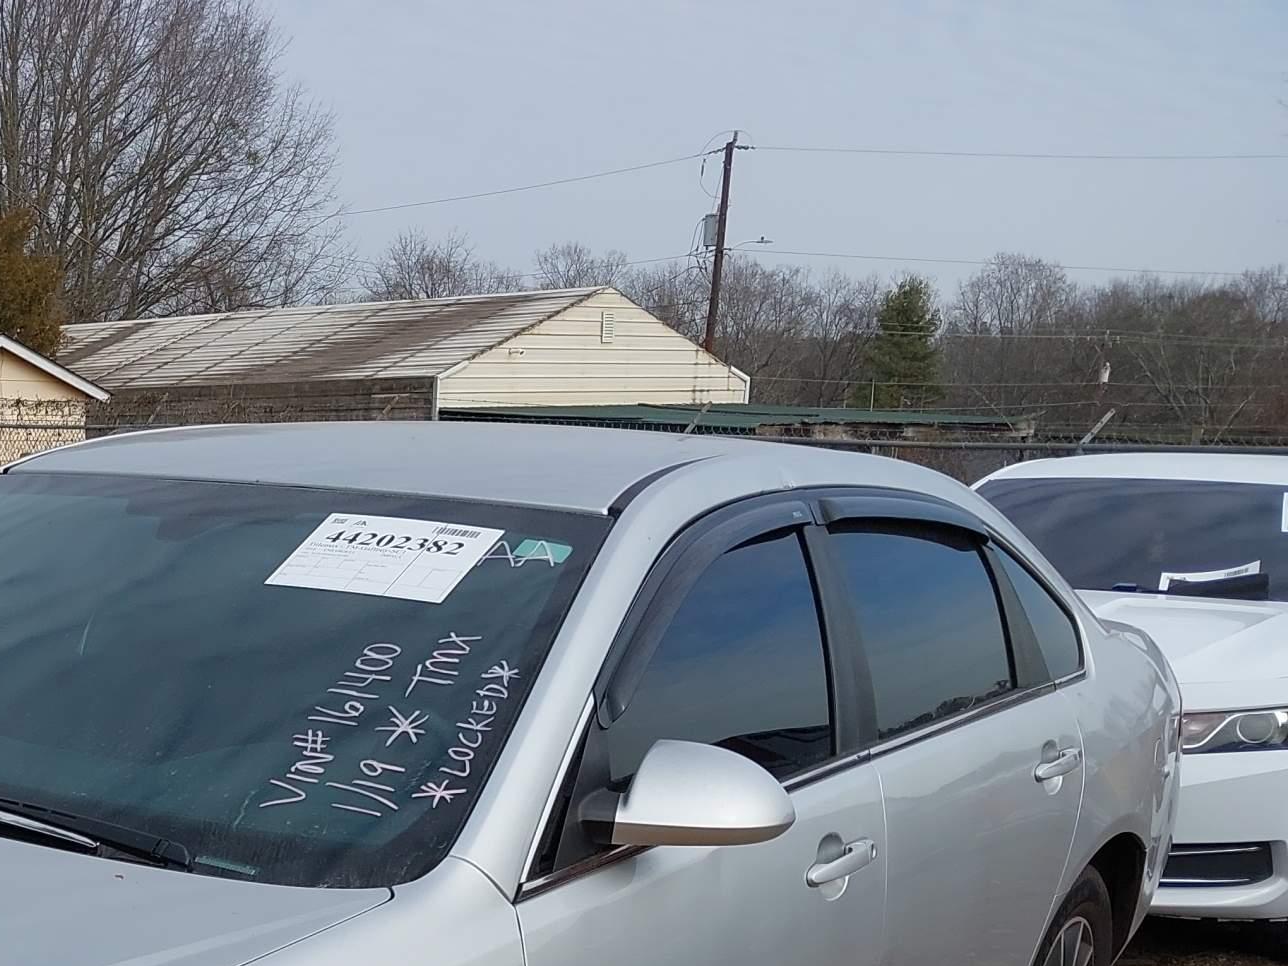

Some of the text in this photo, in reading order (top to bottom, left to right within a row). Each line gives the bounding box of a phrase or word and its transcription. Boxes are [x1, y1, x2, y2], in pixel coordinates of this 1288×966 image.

[325, 529, 465, 556] 44202382
[259, 729, 335, 808] VIN#
[307, 643, 402, 726] 161400
[325, 759, 406, 817] 1/19
